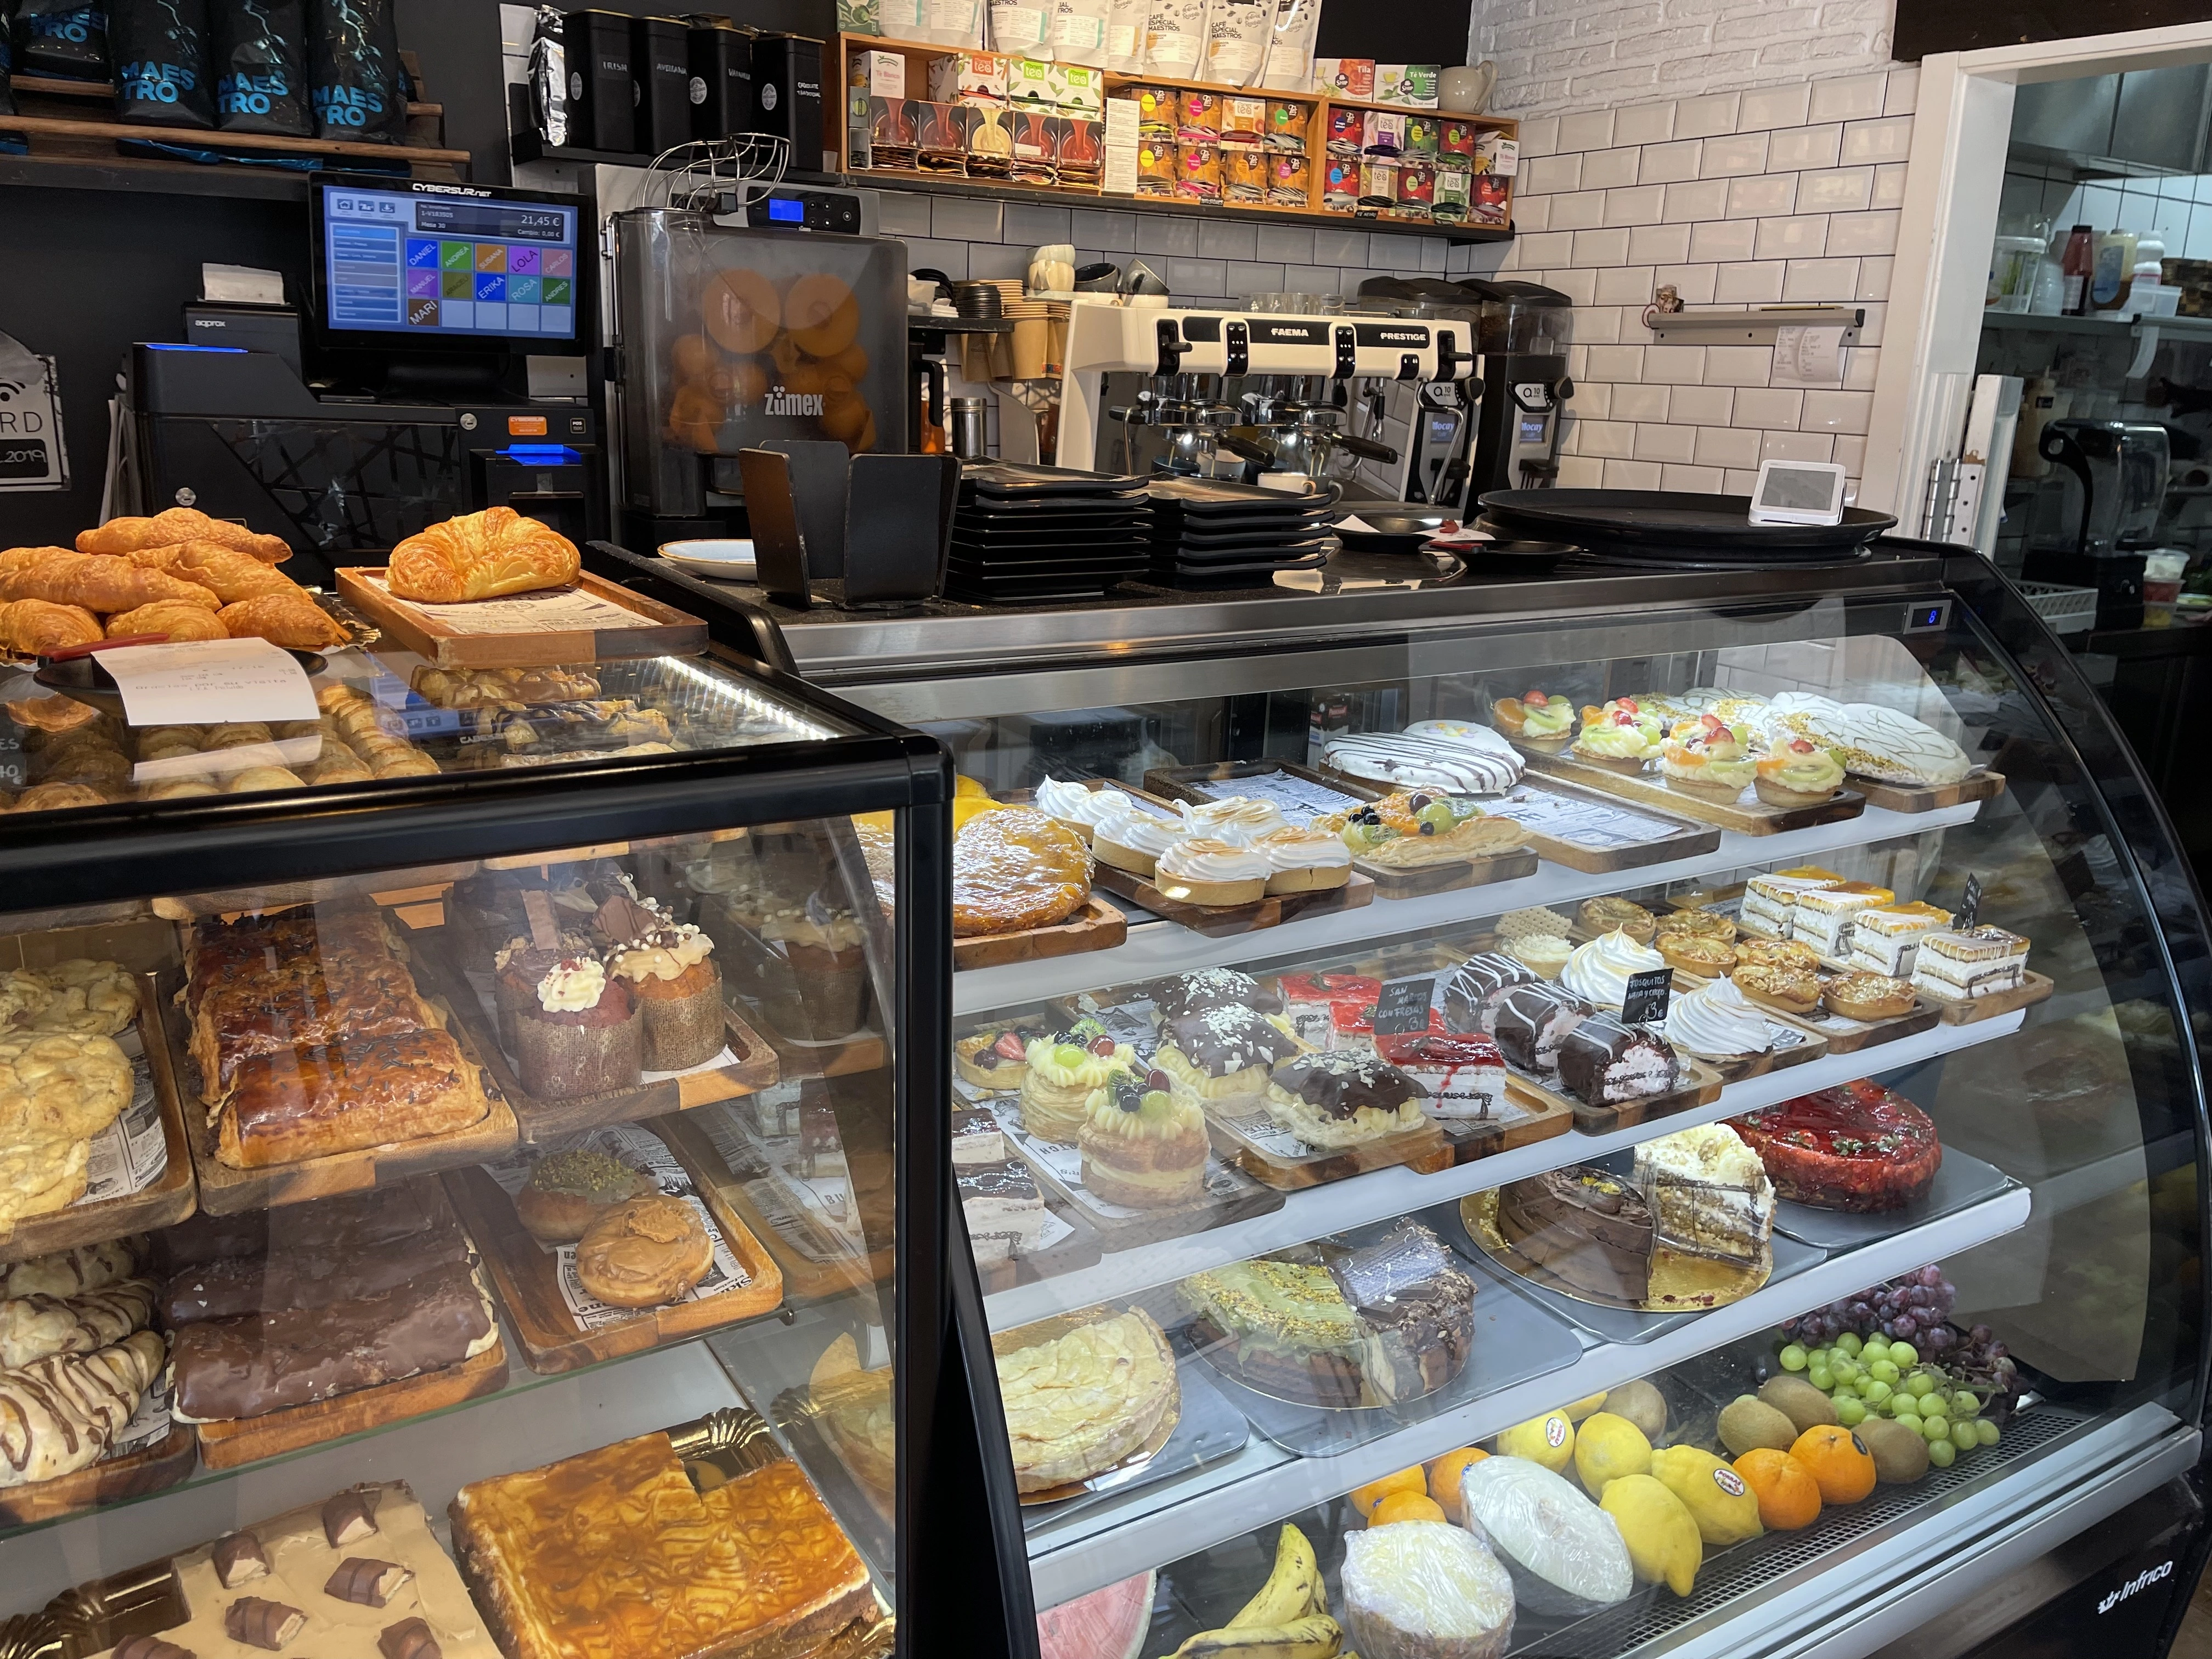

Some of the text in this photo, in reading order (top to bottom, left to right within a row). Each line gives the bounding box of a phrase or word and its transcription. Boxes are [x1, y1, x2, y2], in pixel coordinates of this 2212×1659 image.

[121, 61, 195, 90] MAES
[603, 61, 628, 72] IRISH
[124, 80, 178, 103] TRO
[218, 72, 289, 96] MAES
[219, 92, 270, 114] TRO
[312, 85, 383, 112] MAES
[315, 105, 366, 126] TRO
[521, 215, 560, 226] 21,45 €
[409, 244, 436, 266] DANIEL
[445, 246, 470, 267] ANDREA
[478, 249, 503, 269] SUSANA
[511, 250, 538, 272] LOLA
[410, 274, 436, 295] MANUEL
[478, 276, 505, 300] ERIKA
[512, 279, 537, 301] ROSA
[545, 281, 568, 302] ANDRES
[409, 301, 438, 325] MARI
[1271, 328, 1309, 337] FAEMA
[1380, 332, 1426, 341] PRESTIGE
[1389, 985, 1408, 997] SAN
[84, 1187, 124, 1204] COVENTRY
